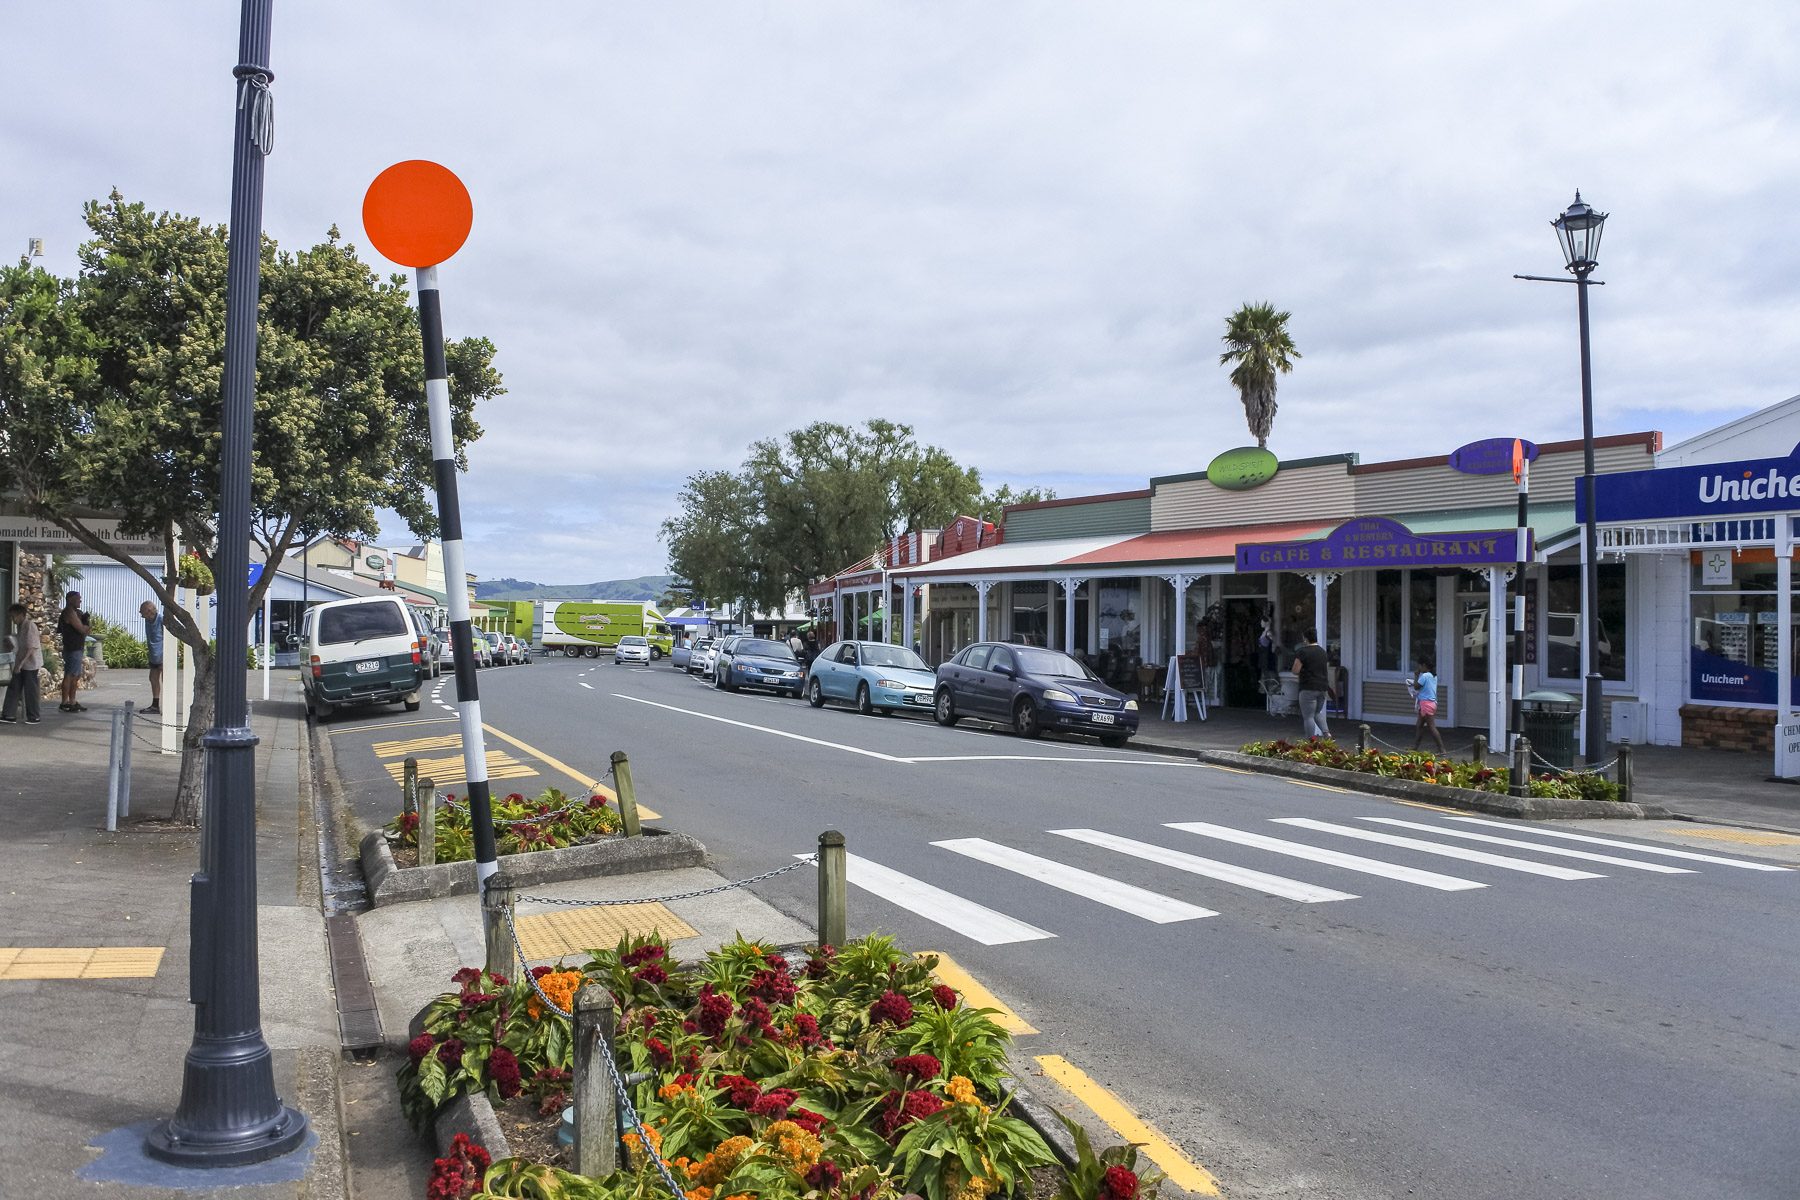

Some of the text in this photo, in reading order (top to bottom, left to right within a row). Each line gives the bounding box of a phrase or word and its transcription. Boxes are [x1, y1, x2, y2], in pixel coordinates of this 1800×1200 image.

[1260, 539, 1497, 563] CAFE & RESTAURANT
[1702, 673, 1744, 685] Unichem
